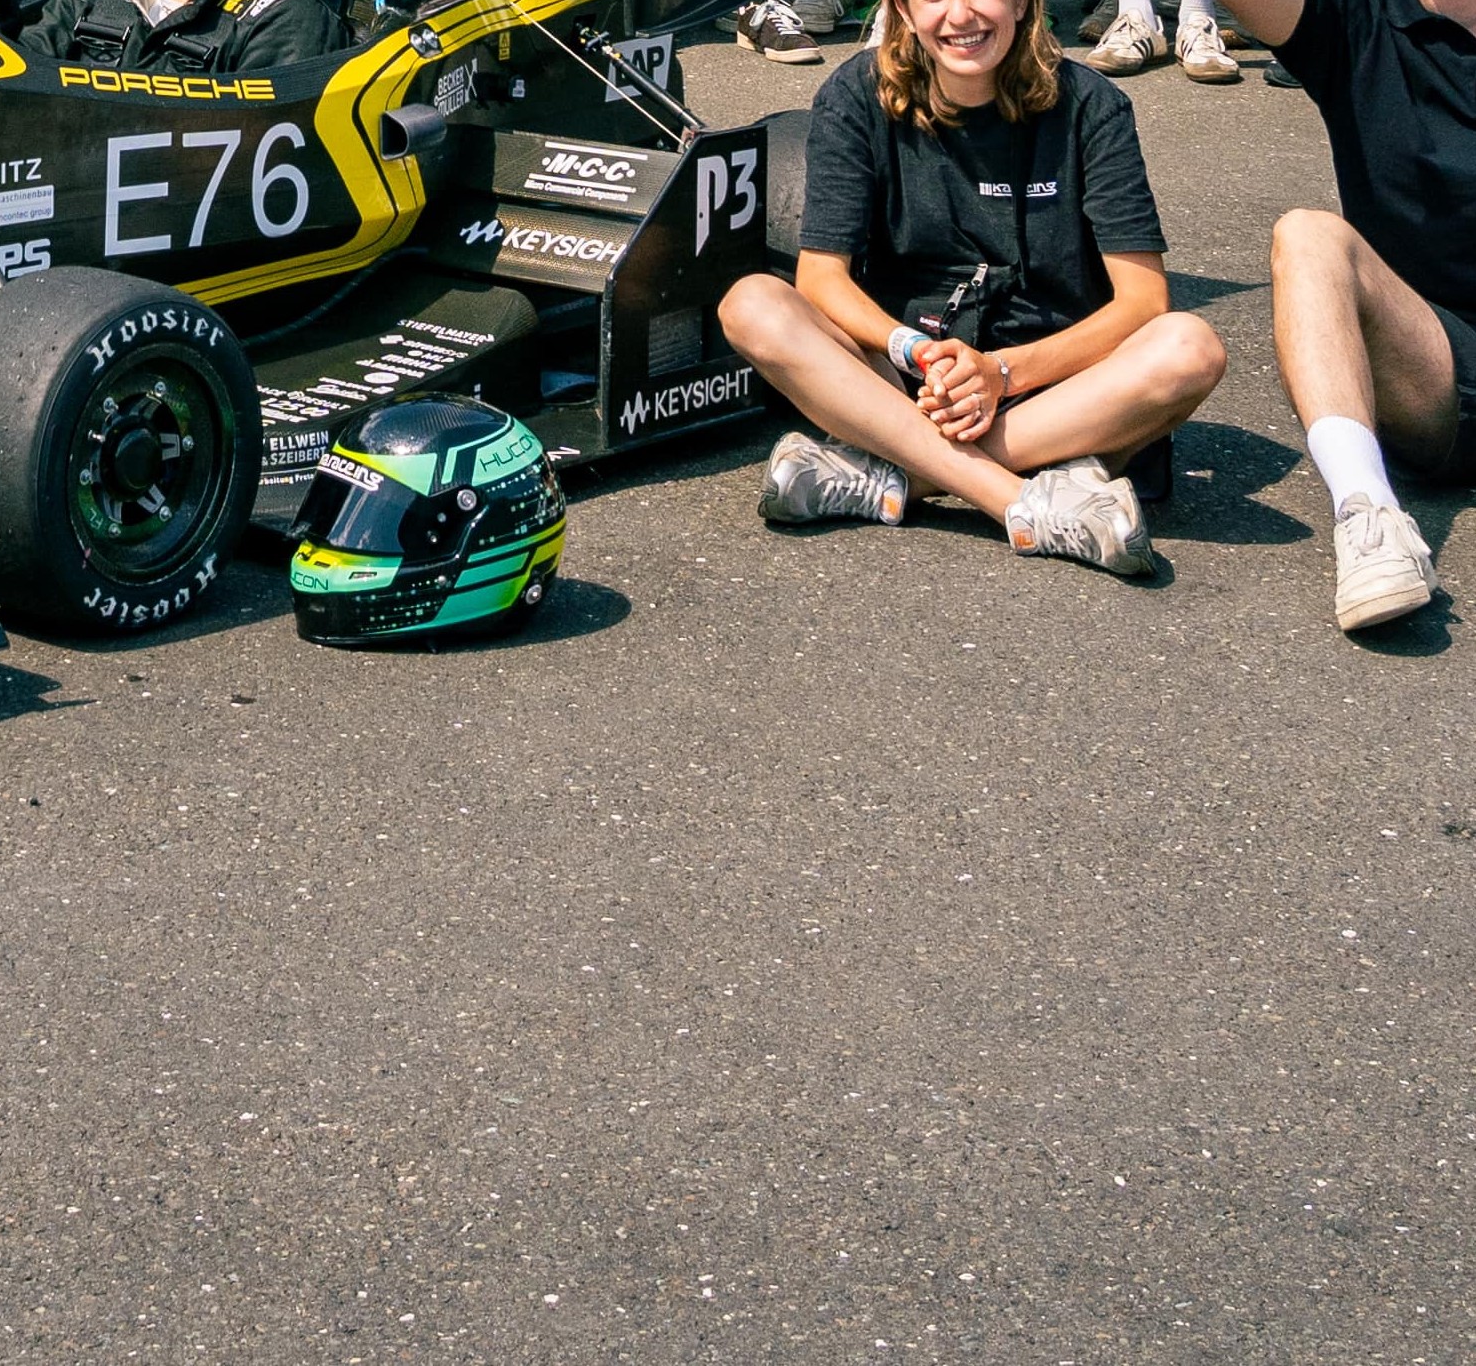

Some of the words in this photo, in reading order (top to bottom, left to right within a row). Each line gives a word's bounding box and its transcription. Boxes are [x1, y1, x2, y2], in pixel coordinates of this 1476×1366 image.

[59, 66, 276, 101] PORSCHE
[437, 65, 465, 91] BECKER
[104, 122, 310, 258] E76
[524, 179, 544, 190] Micro
[545, 182, 584, 198] Commercial
[585, 187, 629, 202] Components
[695, 147, 758, 257] P3
[30, 208, 52, 220] group
[502, 227, 627, 263] KEYSIGH
[654, 367, 753, 419] KEYSIGHT
[270, 431, 329, 452] ELLWEIN
[270, 447, 326, 464] SZEIBERT
